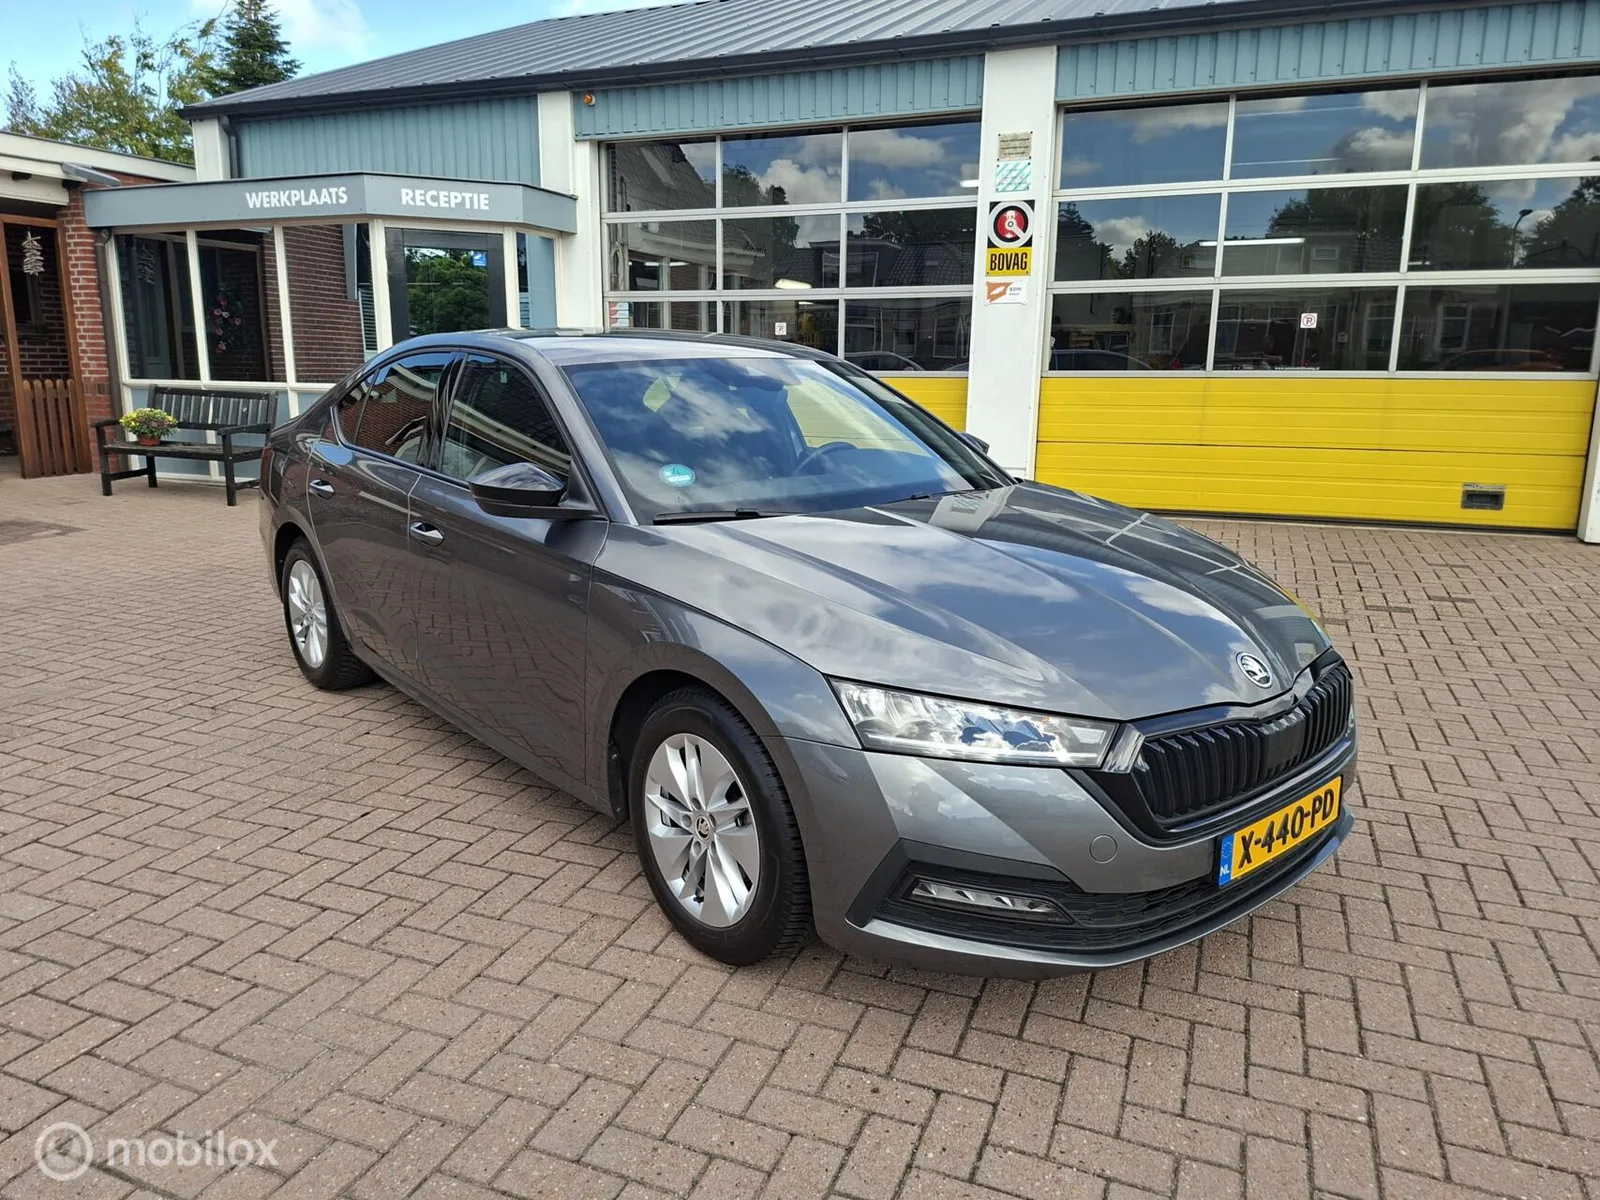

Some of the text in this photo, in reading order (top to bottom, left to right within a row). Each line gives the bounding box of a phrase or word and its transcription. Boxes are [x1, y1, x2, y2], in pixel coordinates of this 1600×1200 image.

[246, 187, 348, 208] WERKPLAATS
[401, 188, 490, 210] RECEPTIE
[990, 253, 1028, 271] BOVAG
[1238, 788, 1335, 869] X-440-PD
[1220, 864, 1230, 876] NL
